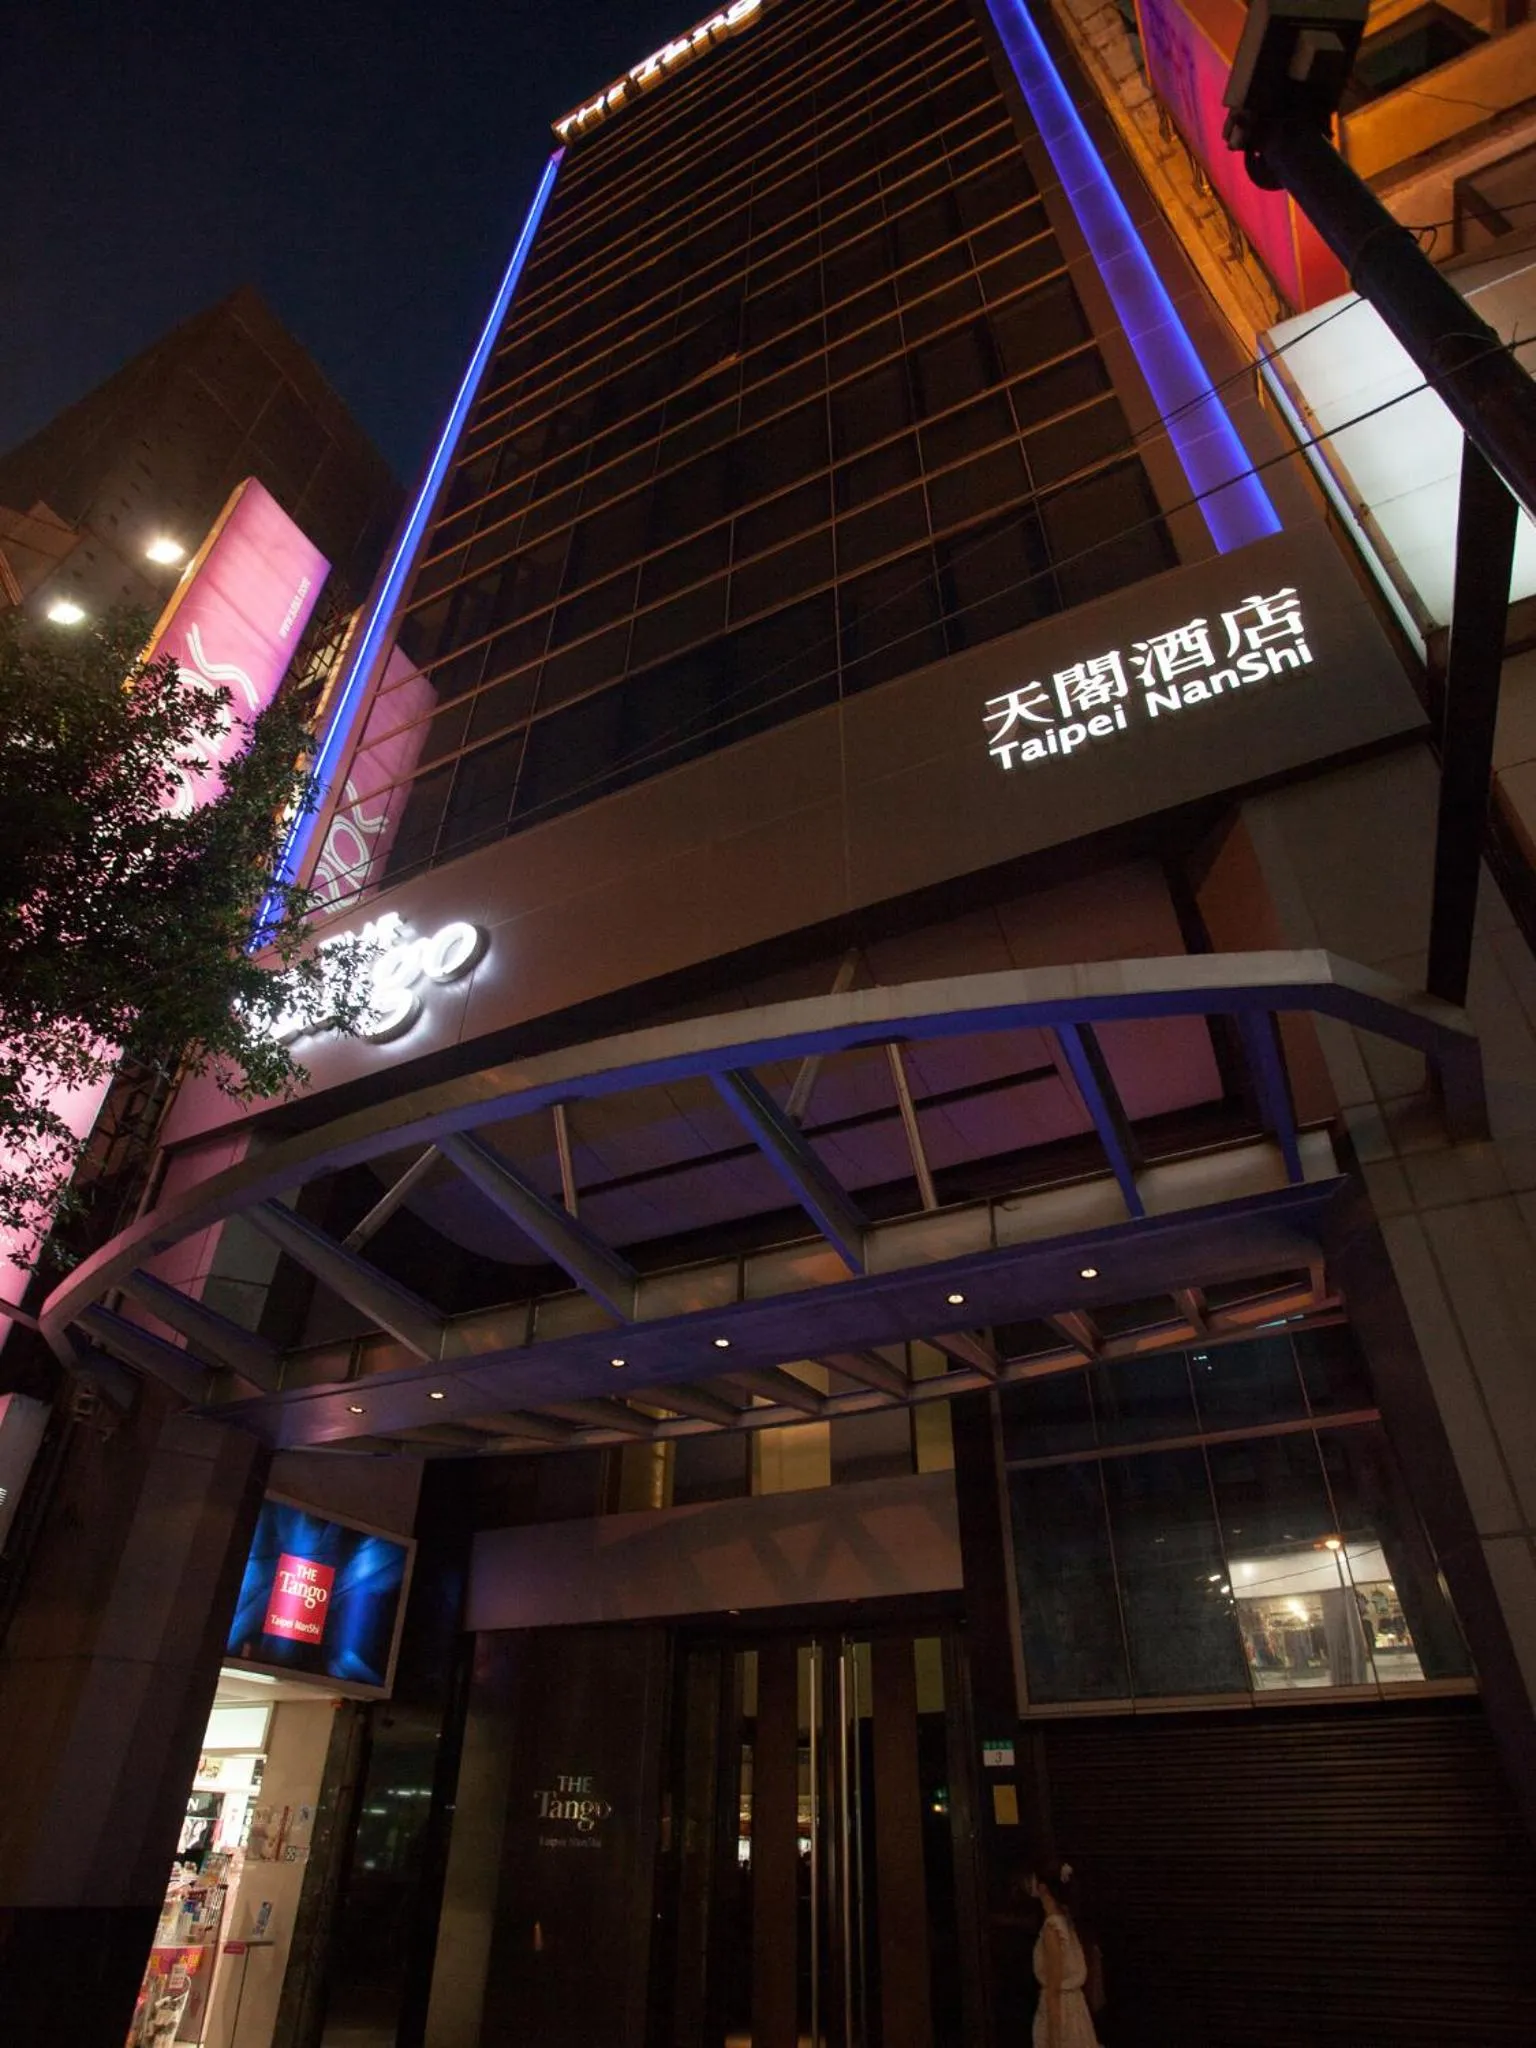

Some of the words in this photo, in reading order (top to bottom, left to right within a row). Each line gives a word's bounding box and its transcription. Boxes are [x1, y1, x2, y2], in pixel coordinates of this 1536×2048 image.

[983, 588, 1304, 744] 天閣酒店
[989, 703, 1128, 769] Taipei
[1145, 638, 1313, 717] NanShi
[279, 1571, 327, 1609] Tango
[296, 1564, 318, 1582] THE
[557, 1775, 593, 1793] THE
[533, 1790, 612, 1832] Tango
